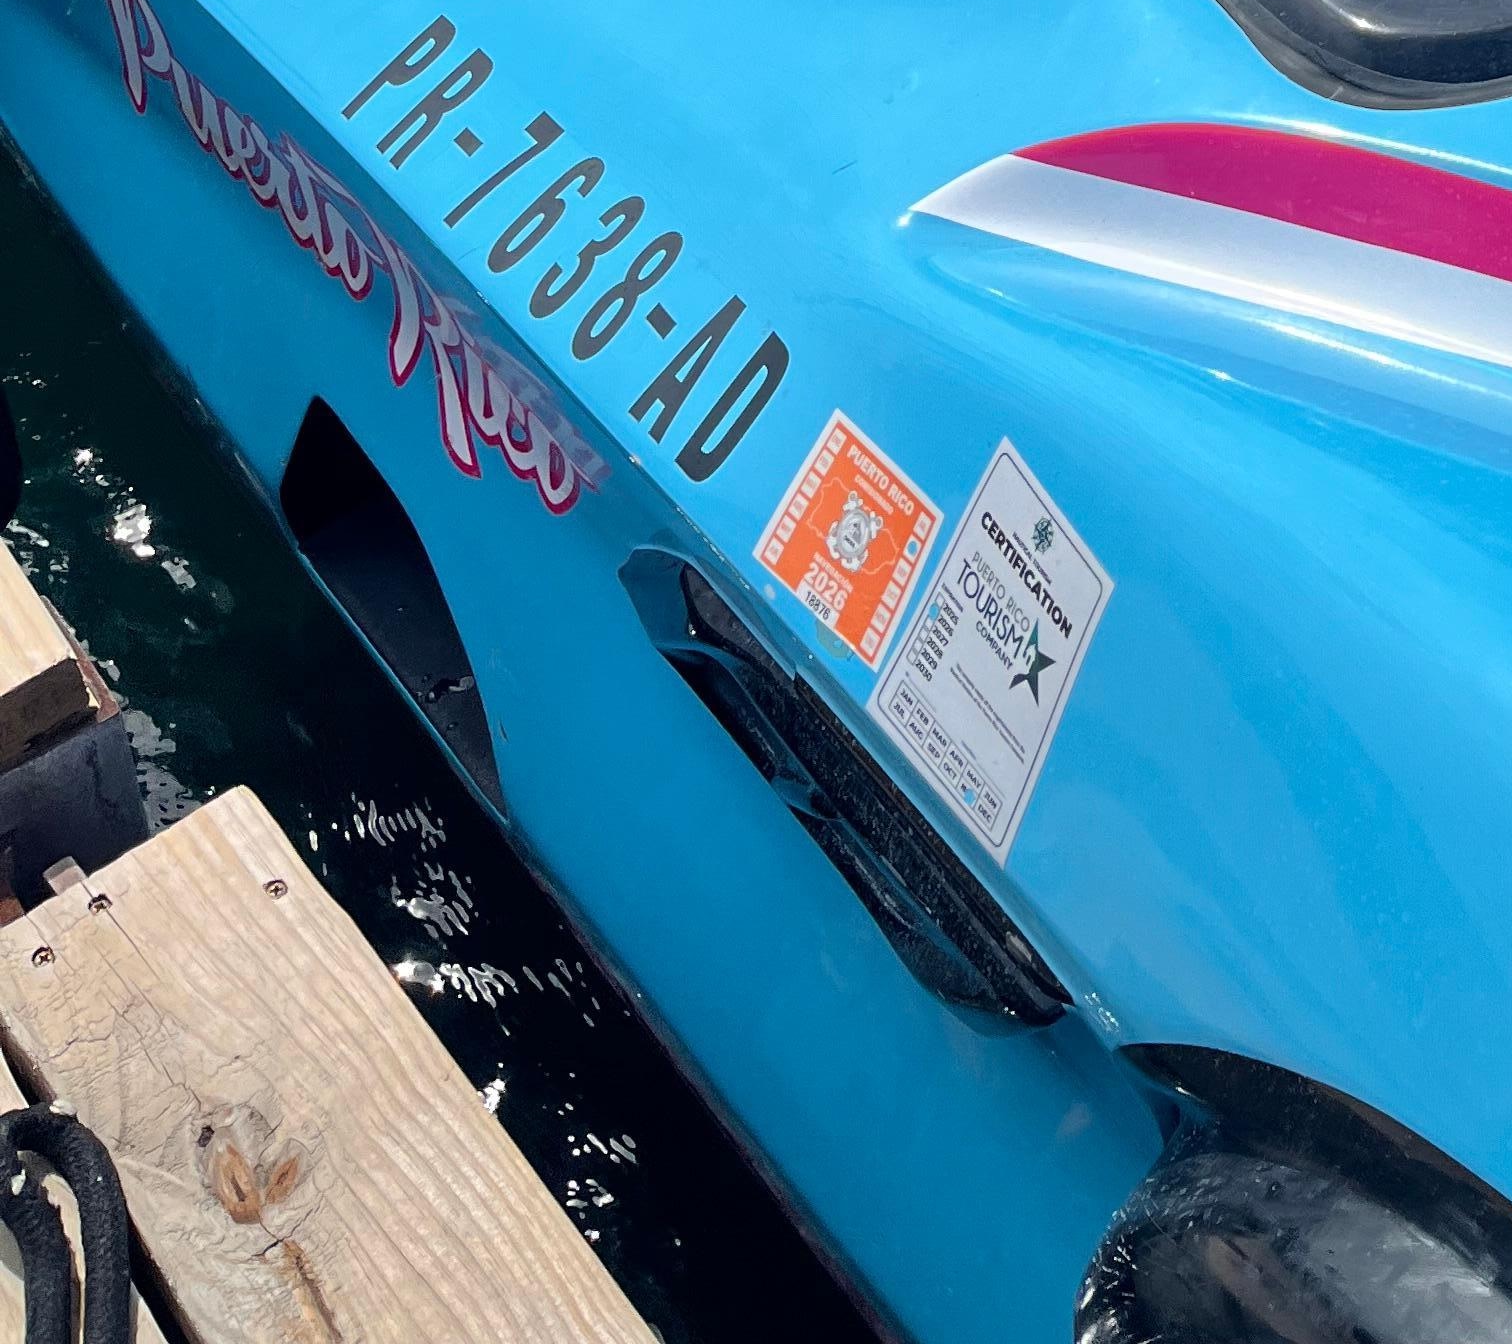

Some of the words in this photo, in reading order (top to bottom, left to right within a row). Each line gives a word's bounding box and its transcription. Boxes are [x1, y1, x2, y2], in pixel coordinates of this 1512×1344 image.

[342, 15, 790, 483] PR-7638-AD
[846, 443, 889, 492] PUERTO
[887, 482, 915, 517] RICO
[803, 561, 848, 611] 2026
[954, 560, 1024, 658] TOURISM
[970, 551, 1006, 601] PUERTO
[1005, 596, 1031, 634] RICO
[979, 510, 1072, 638] CERTIFICATION
[915, 659, 932, 682] 2030
[931, 625, 948, 648] 2027
[975, 620, 1012, 671] COMPANY
